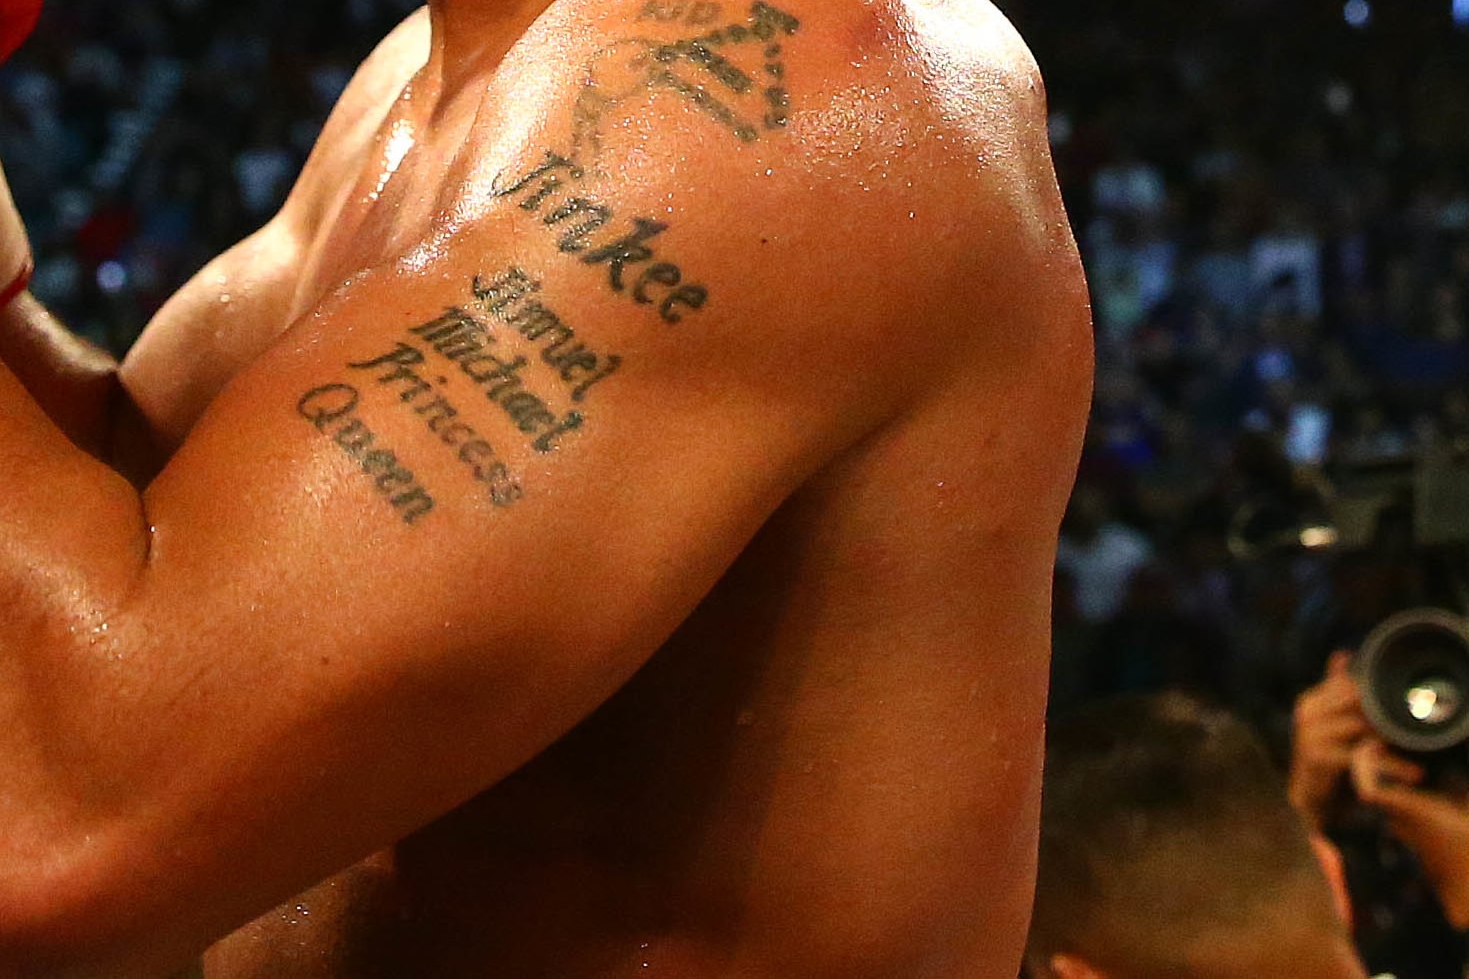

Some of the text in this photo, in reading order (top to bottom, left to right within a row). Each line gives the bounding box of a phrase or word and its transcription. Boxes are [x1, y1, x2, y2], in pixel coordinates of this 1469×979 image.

[491, 149, 709, 325] Jinkee
[295, 382, 436, 525] Queen
[347, 342, 523, 508] Princess
[408, 305, 585, 455] Michael
